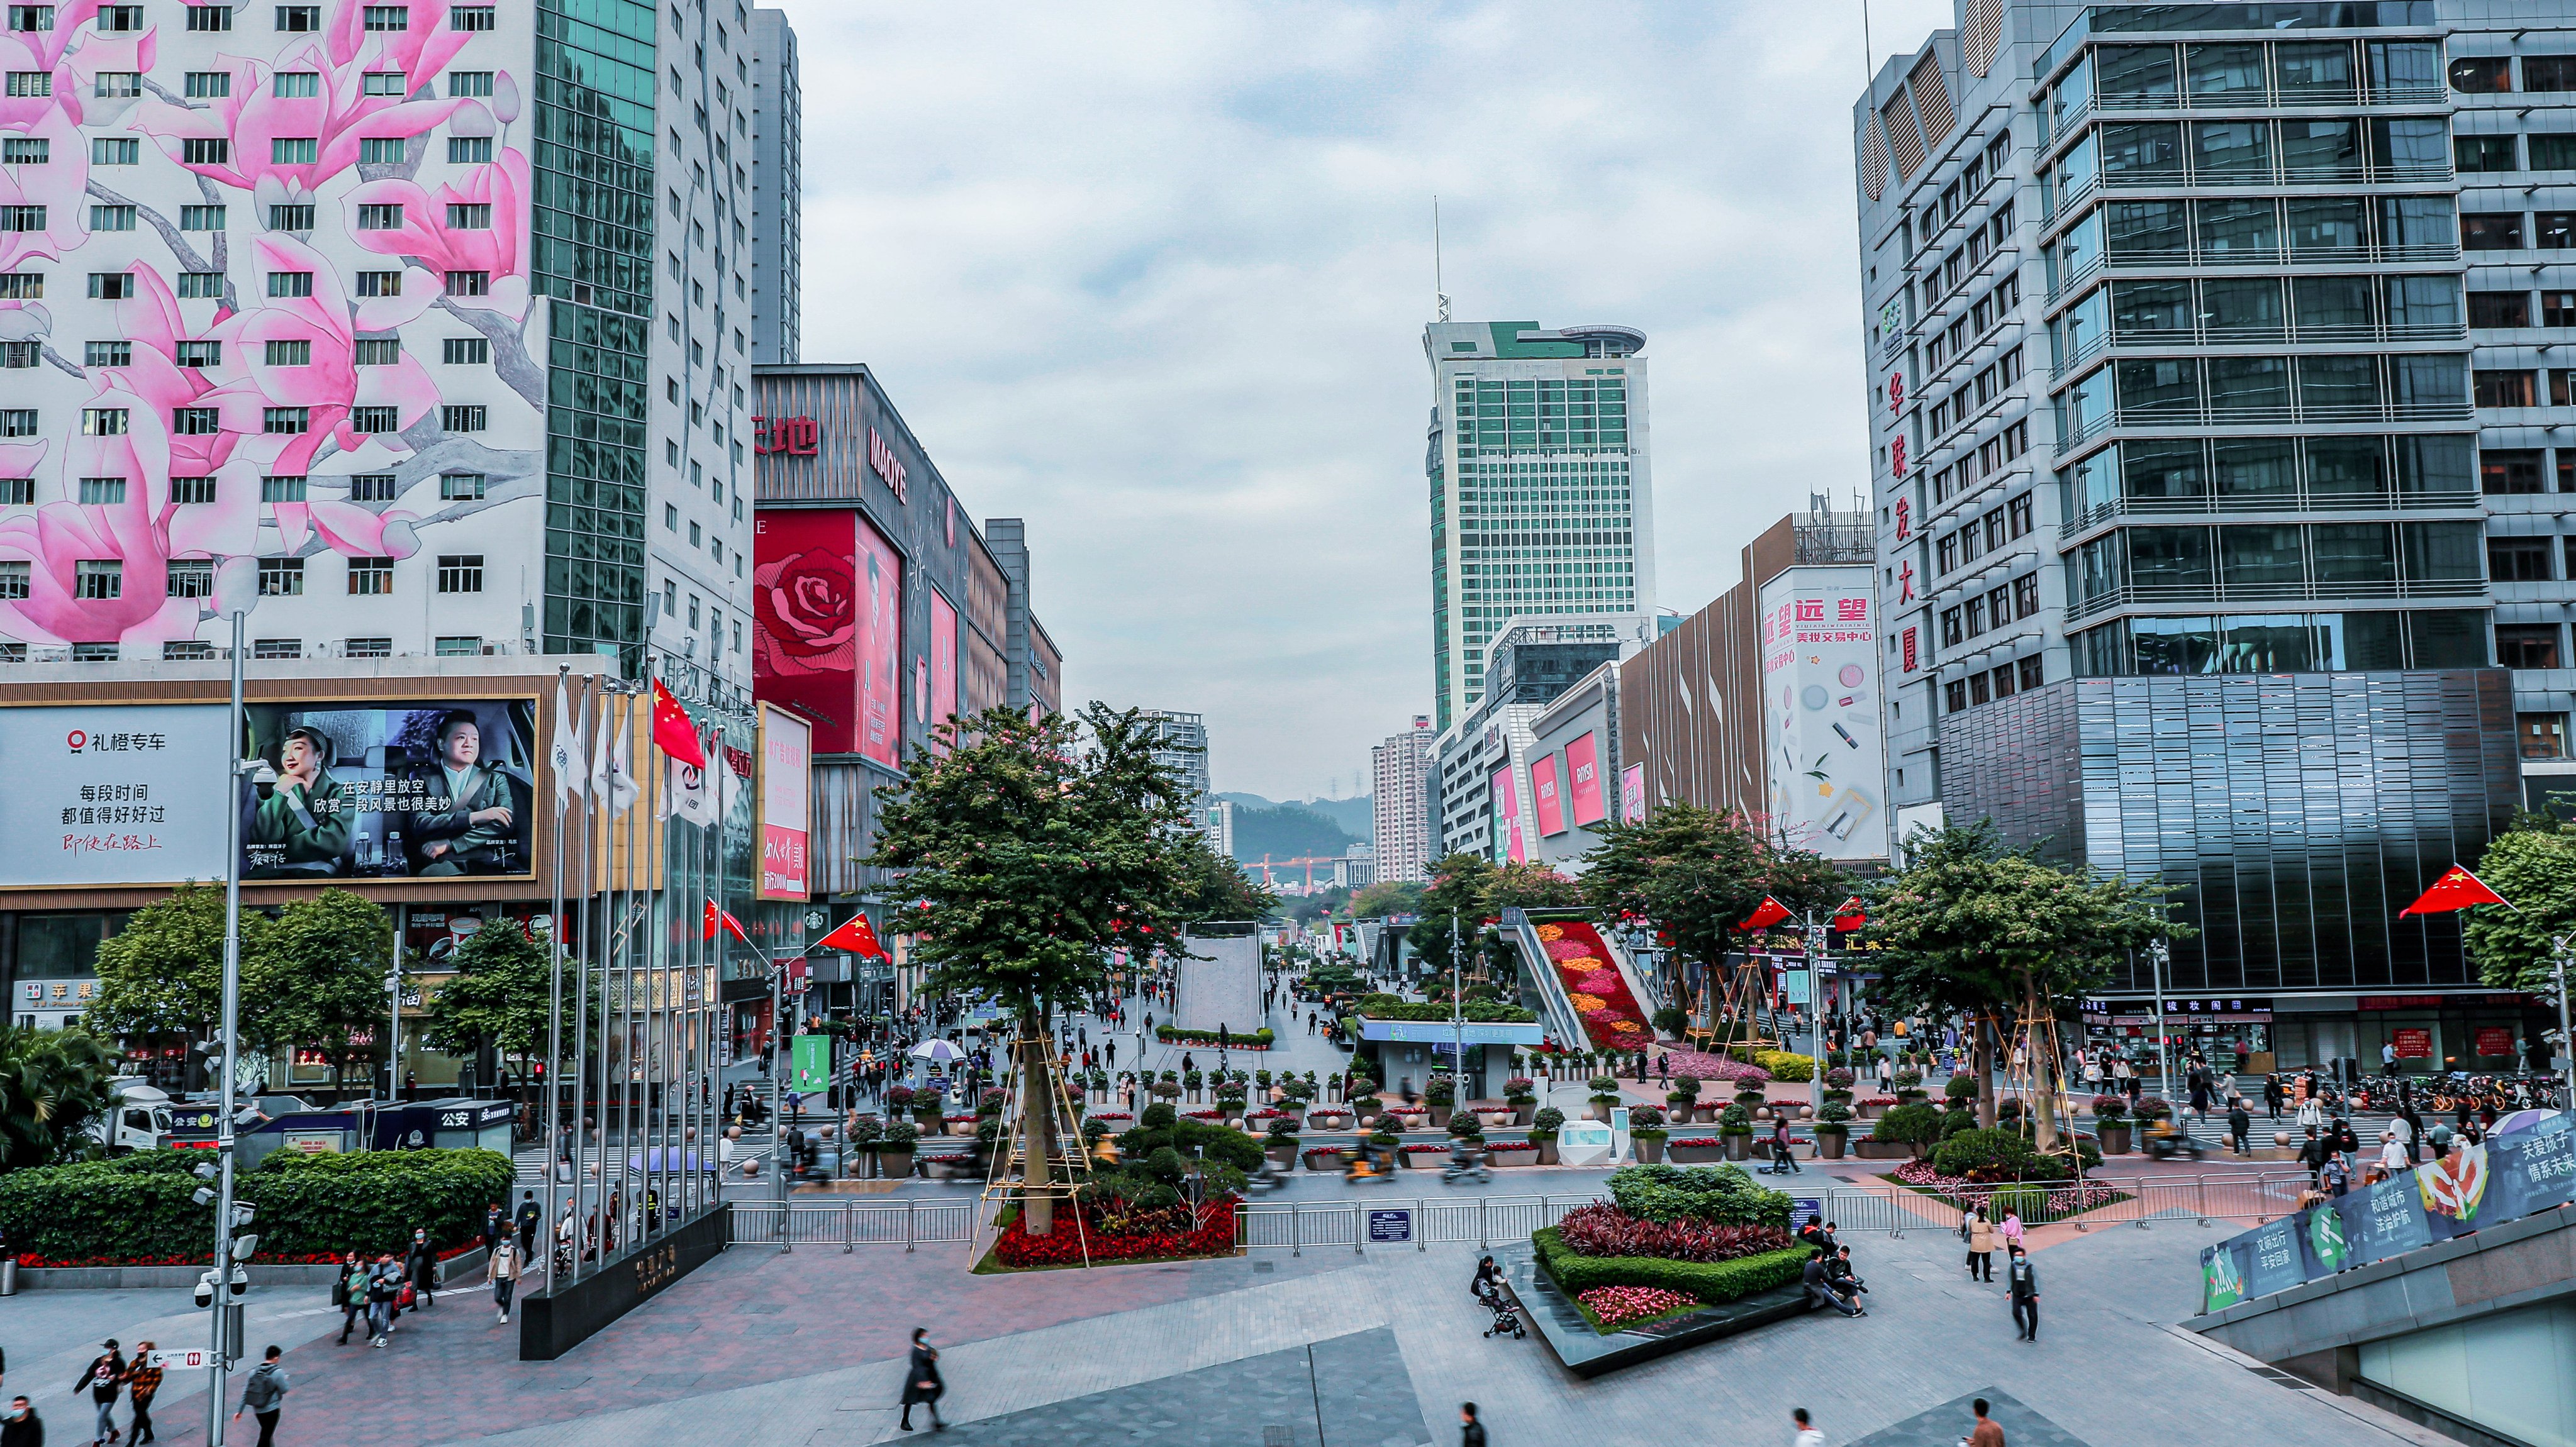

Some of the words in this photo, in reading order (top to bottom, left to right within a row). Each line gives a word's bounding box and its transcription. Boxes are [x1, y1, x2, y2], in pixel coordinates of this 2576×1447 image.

[869, 424, 906, 506] MAOYE
[1888, 372, 1917, 674] 华联发大厦
[1795, 599, 1866, 621] 远望
[1765, 602, 1792, 646] 远望
[1797, 631, 1872, 643] 美妆交易中心
[91, 733, 166, 751] 礼橙专车
[80, 784, 148, 802] 每段时间
[343, 779, 425, 795] 在安静里放空
[62, 806, 165, 825] 都值得好好过
[313, 796, 453, 814] 欣赏一段风景也很美妙
[62, 833, 162, 858] 即使在路上
[1442, 1028, 1476, 1037] 垃圾落地
[174, 1117, 198, 1126] 公安
[442, 1111, 469, 1127] 公安
[2522, 1129, 2568, 1161] 关爱孩子
[2528, 1152, 2576, 1183] 情系未来
[2370, 1190, 2406, 1214] 和谐城市
[2375, 1208, 2411, 1233] 法治护航
[2256, 1230, 2286, 1253] 文明出行
[2260, 1249, 2291, 1270] 平安回家
